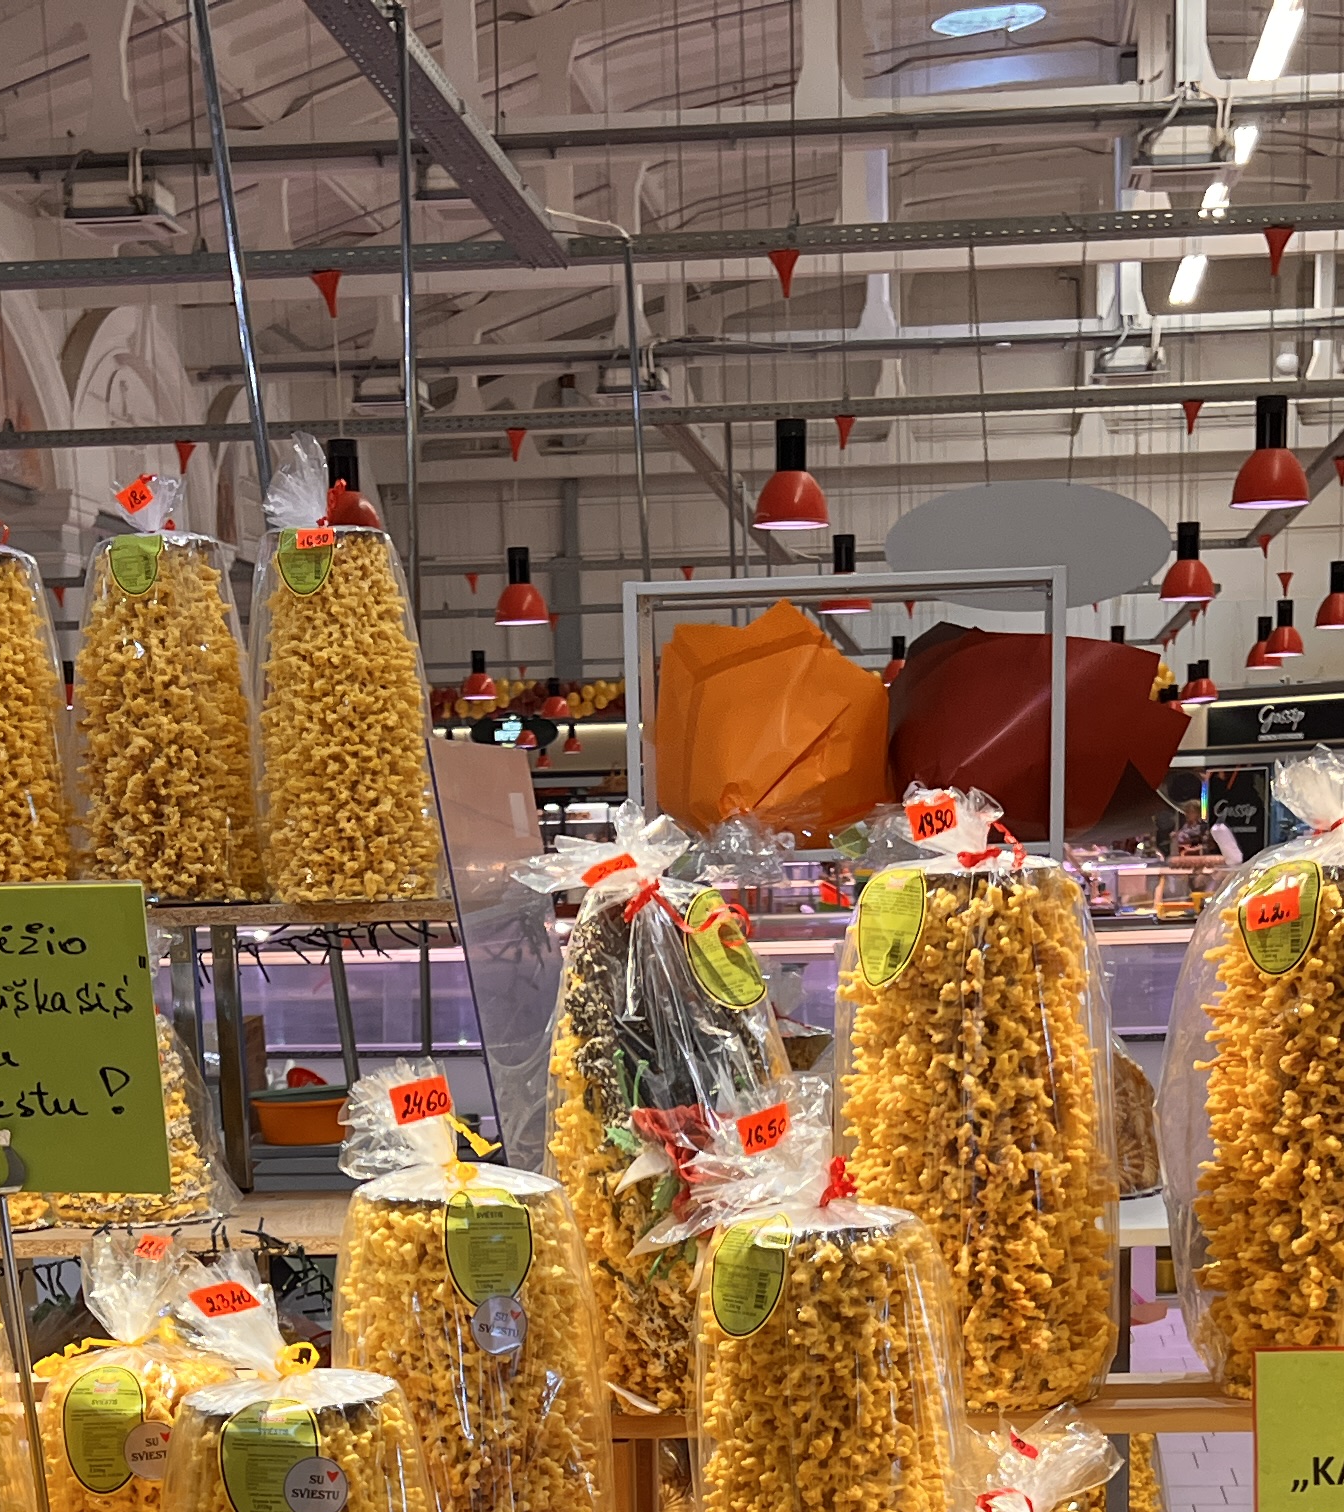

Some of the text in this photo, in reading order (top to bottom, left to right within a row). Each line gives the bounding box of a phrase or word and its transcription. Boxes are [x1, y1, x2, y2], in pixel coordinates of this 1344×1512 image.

[1257, 704, 1305, 733] Gossip
[402, 1089, 447, 1118] 24,60
[746, 1118, 786, 1147] 16,50
[145, 1437, 159, 1448] SU
[131, 1449, 168, 1462] SVIEST
[308, 1474, 325, 1485] SU
[290, 1487, 340, 1501] SVIESTU
